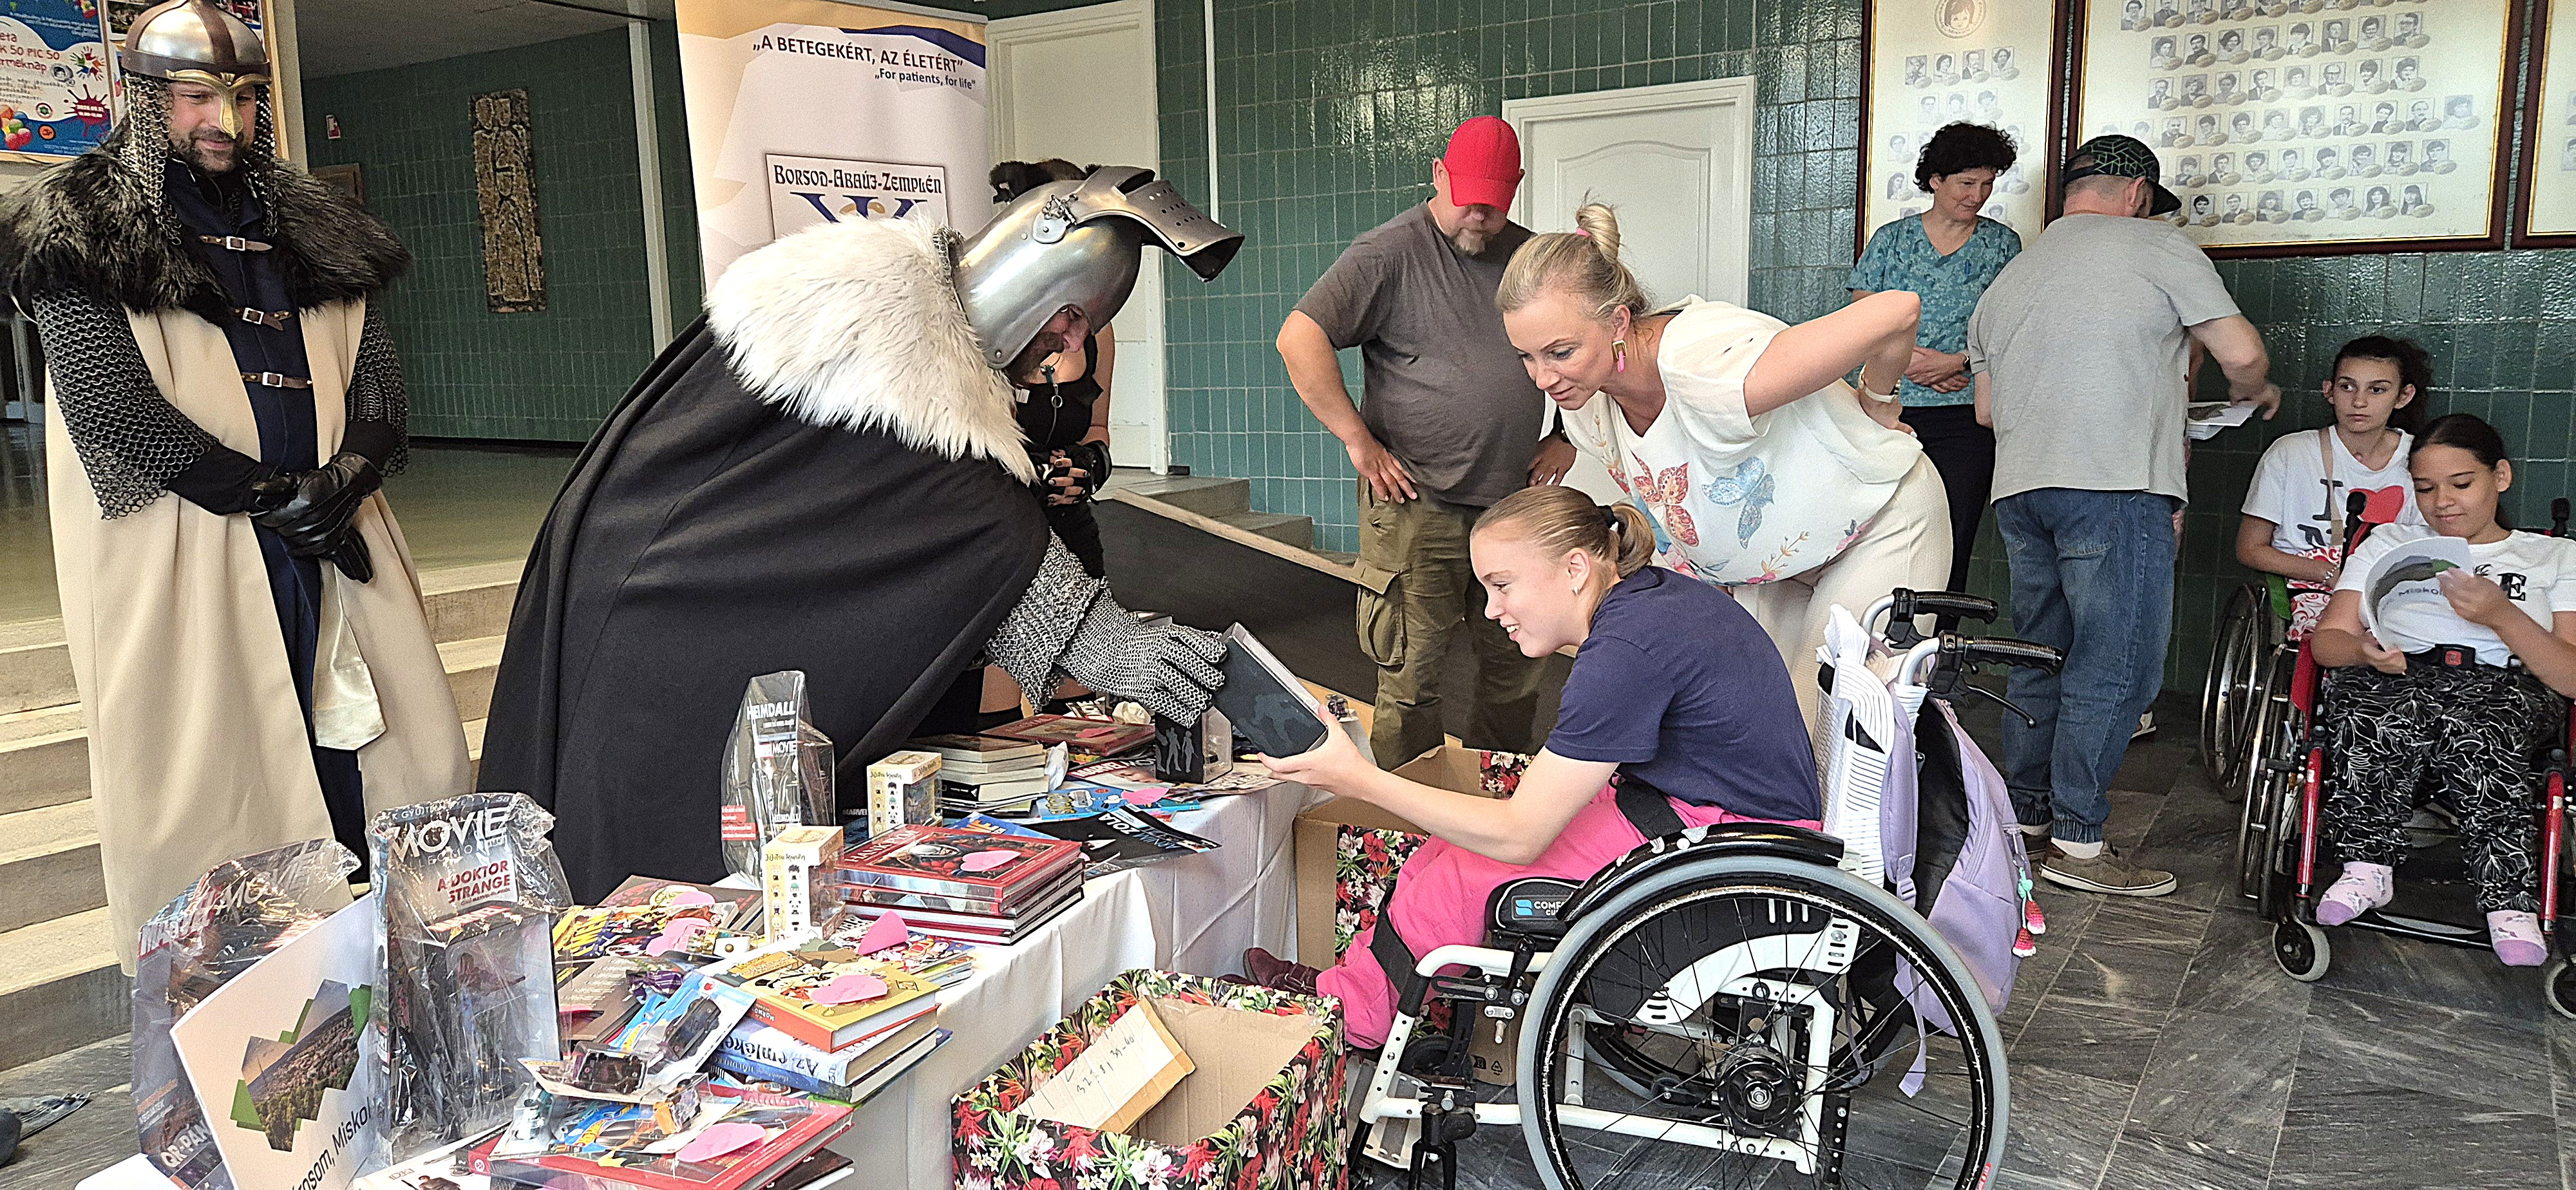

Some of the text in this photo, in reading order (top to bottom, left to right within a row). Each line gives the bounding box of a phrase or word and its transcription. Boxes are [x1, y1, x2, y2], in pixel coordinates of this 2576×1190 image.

[10, 44, 24, 55] 50
[27, 48, 43, 59] PIC
[46, 50, 60, 60] 50
[777, 37, 876, 65] BETEGEKÉRT,
[880, 50, 899, 65] AZ
[903, 49, 963, 73] ÉLETÉRT”
[898, 71, 943, 86] patients,
[945, 75, 958, 87] for
[959, 77, 976, 90] life”
[747, 701, 796, 720] HEIMDALL
[773, 741, 797, 754] MOVIE
[1071, 762, 1127, 777] MARVEL
[389, 807, 511, 862] MOVIE
[1099, 813, 1139, 835] ZOLA
[844, 842, 893, 863] HANK
[437, 860, 509, 892] A DOKTOR
[448, 874, 510, 903] STRANGE
[793, 1057, 819, 1078] Az
